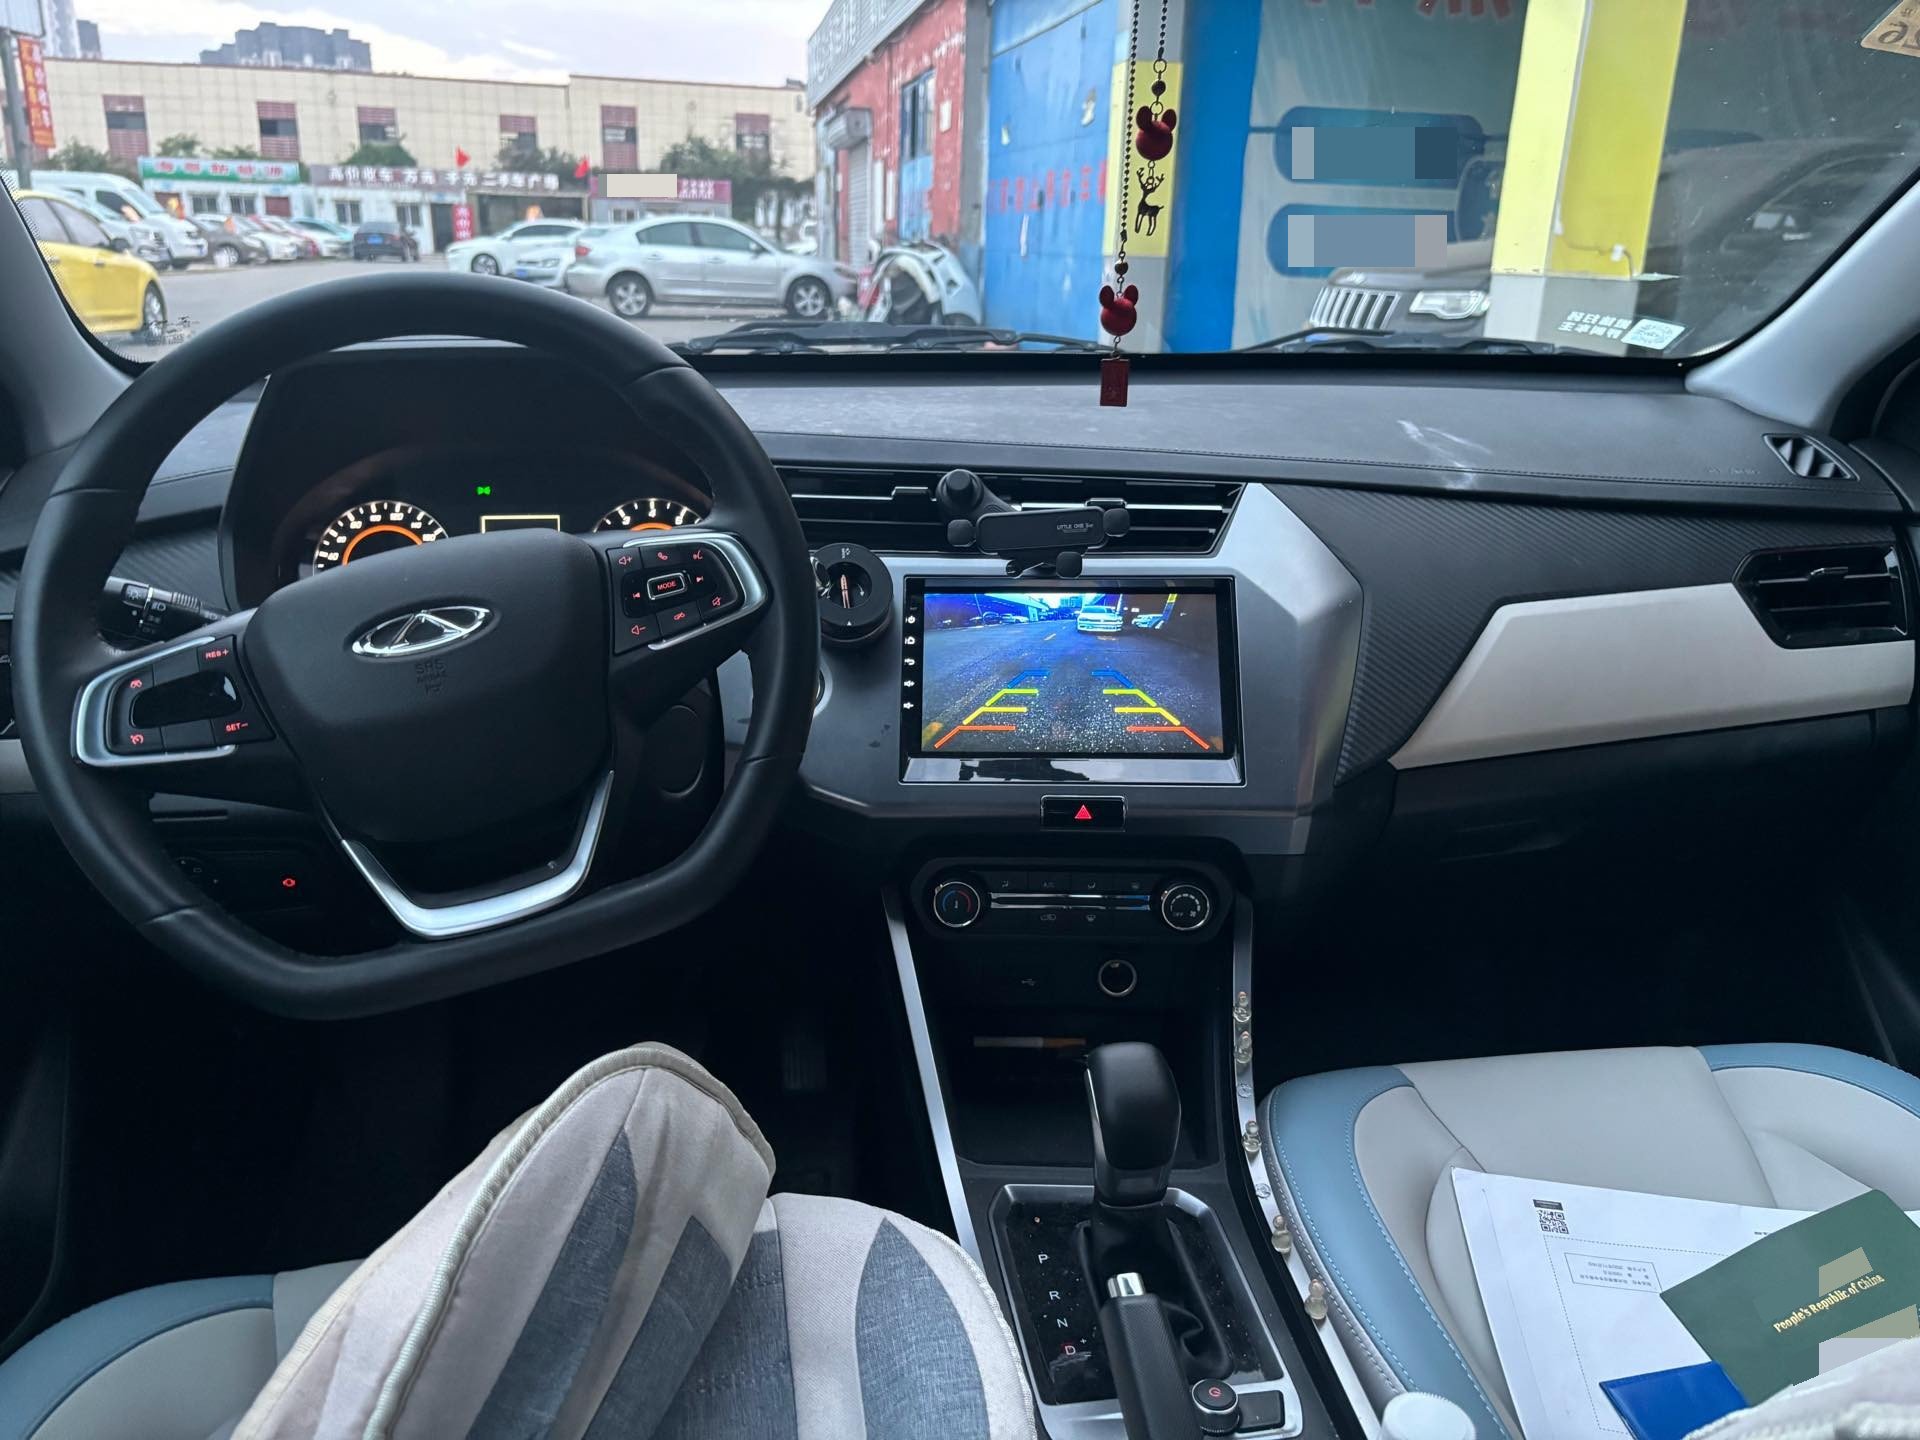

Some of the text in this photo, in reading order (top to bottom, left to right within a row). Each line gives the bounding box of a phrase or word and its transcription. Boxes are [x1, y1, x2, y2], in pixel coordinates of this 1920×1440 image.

[648, 508, 656, 518] 4
[657, 580, 676, 591] MODE
[1038, 1254, 1049, 1264] P
[1048, 1290, 1061, 1301] R
[1773, 1274, 1885, 1333] People's Republic of China
[1056, 1318, 1069, 1328] N
[1064, 1345, 1076, 1355] D
